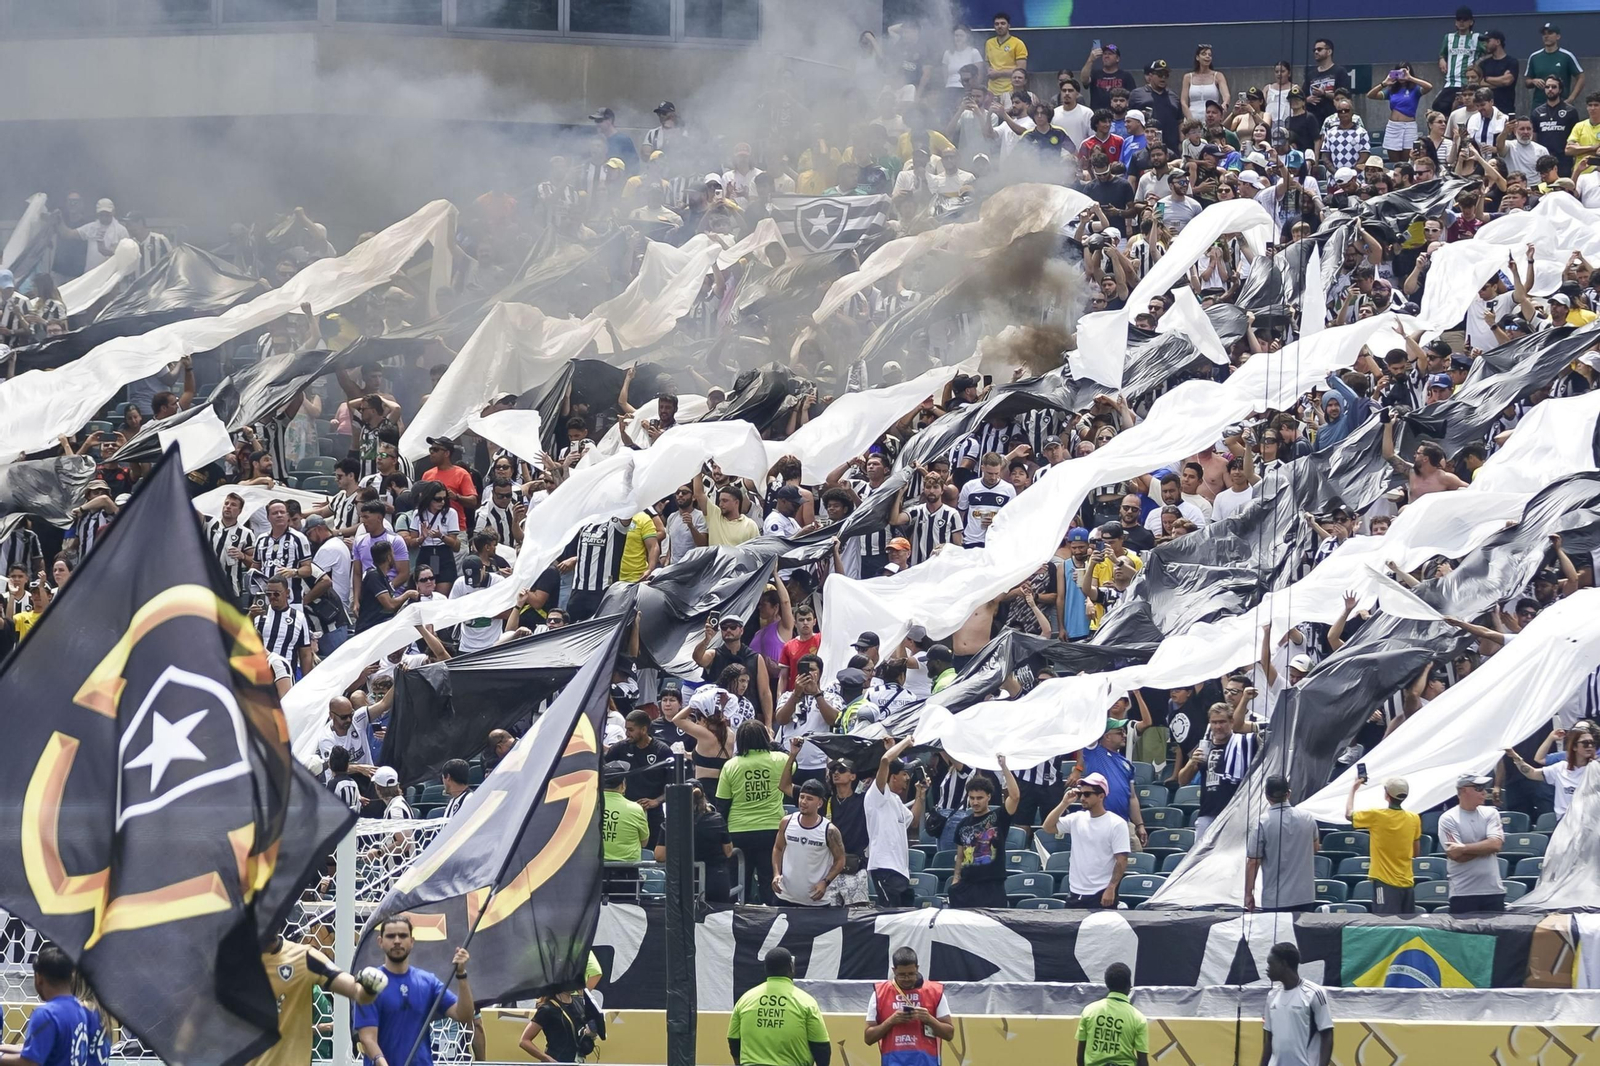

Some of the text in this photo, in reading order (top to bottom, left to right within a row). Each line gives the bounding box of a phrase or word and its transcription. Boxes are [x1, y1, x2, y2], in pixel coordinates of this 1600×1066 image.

[1347, 69, 1356, 89] 1
[744, 769, 771, 781] CSC
[745, 780, 771, 791] EVENT
[745, 791, 772, 802] STAFF
[602, 809, 620, 821] SC
[602, 820, 619, 832] ENT
[602, 831, 618, 843] AFF
[759, 994, 788, 1007] CSC
[895, 993, 919, 1002] CLUB
[892, 1001, 922, 1011] MEIA
[757, 1007, 786, 1018] EVENT
[756, 1017, 785, 1028] STAFF
[1096, 1014, 1124, 1030] CSC
[1093, 1027, 1122, 1043] EVENT
[1092, 1039, 1120, 1055] STAFF
